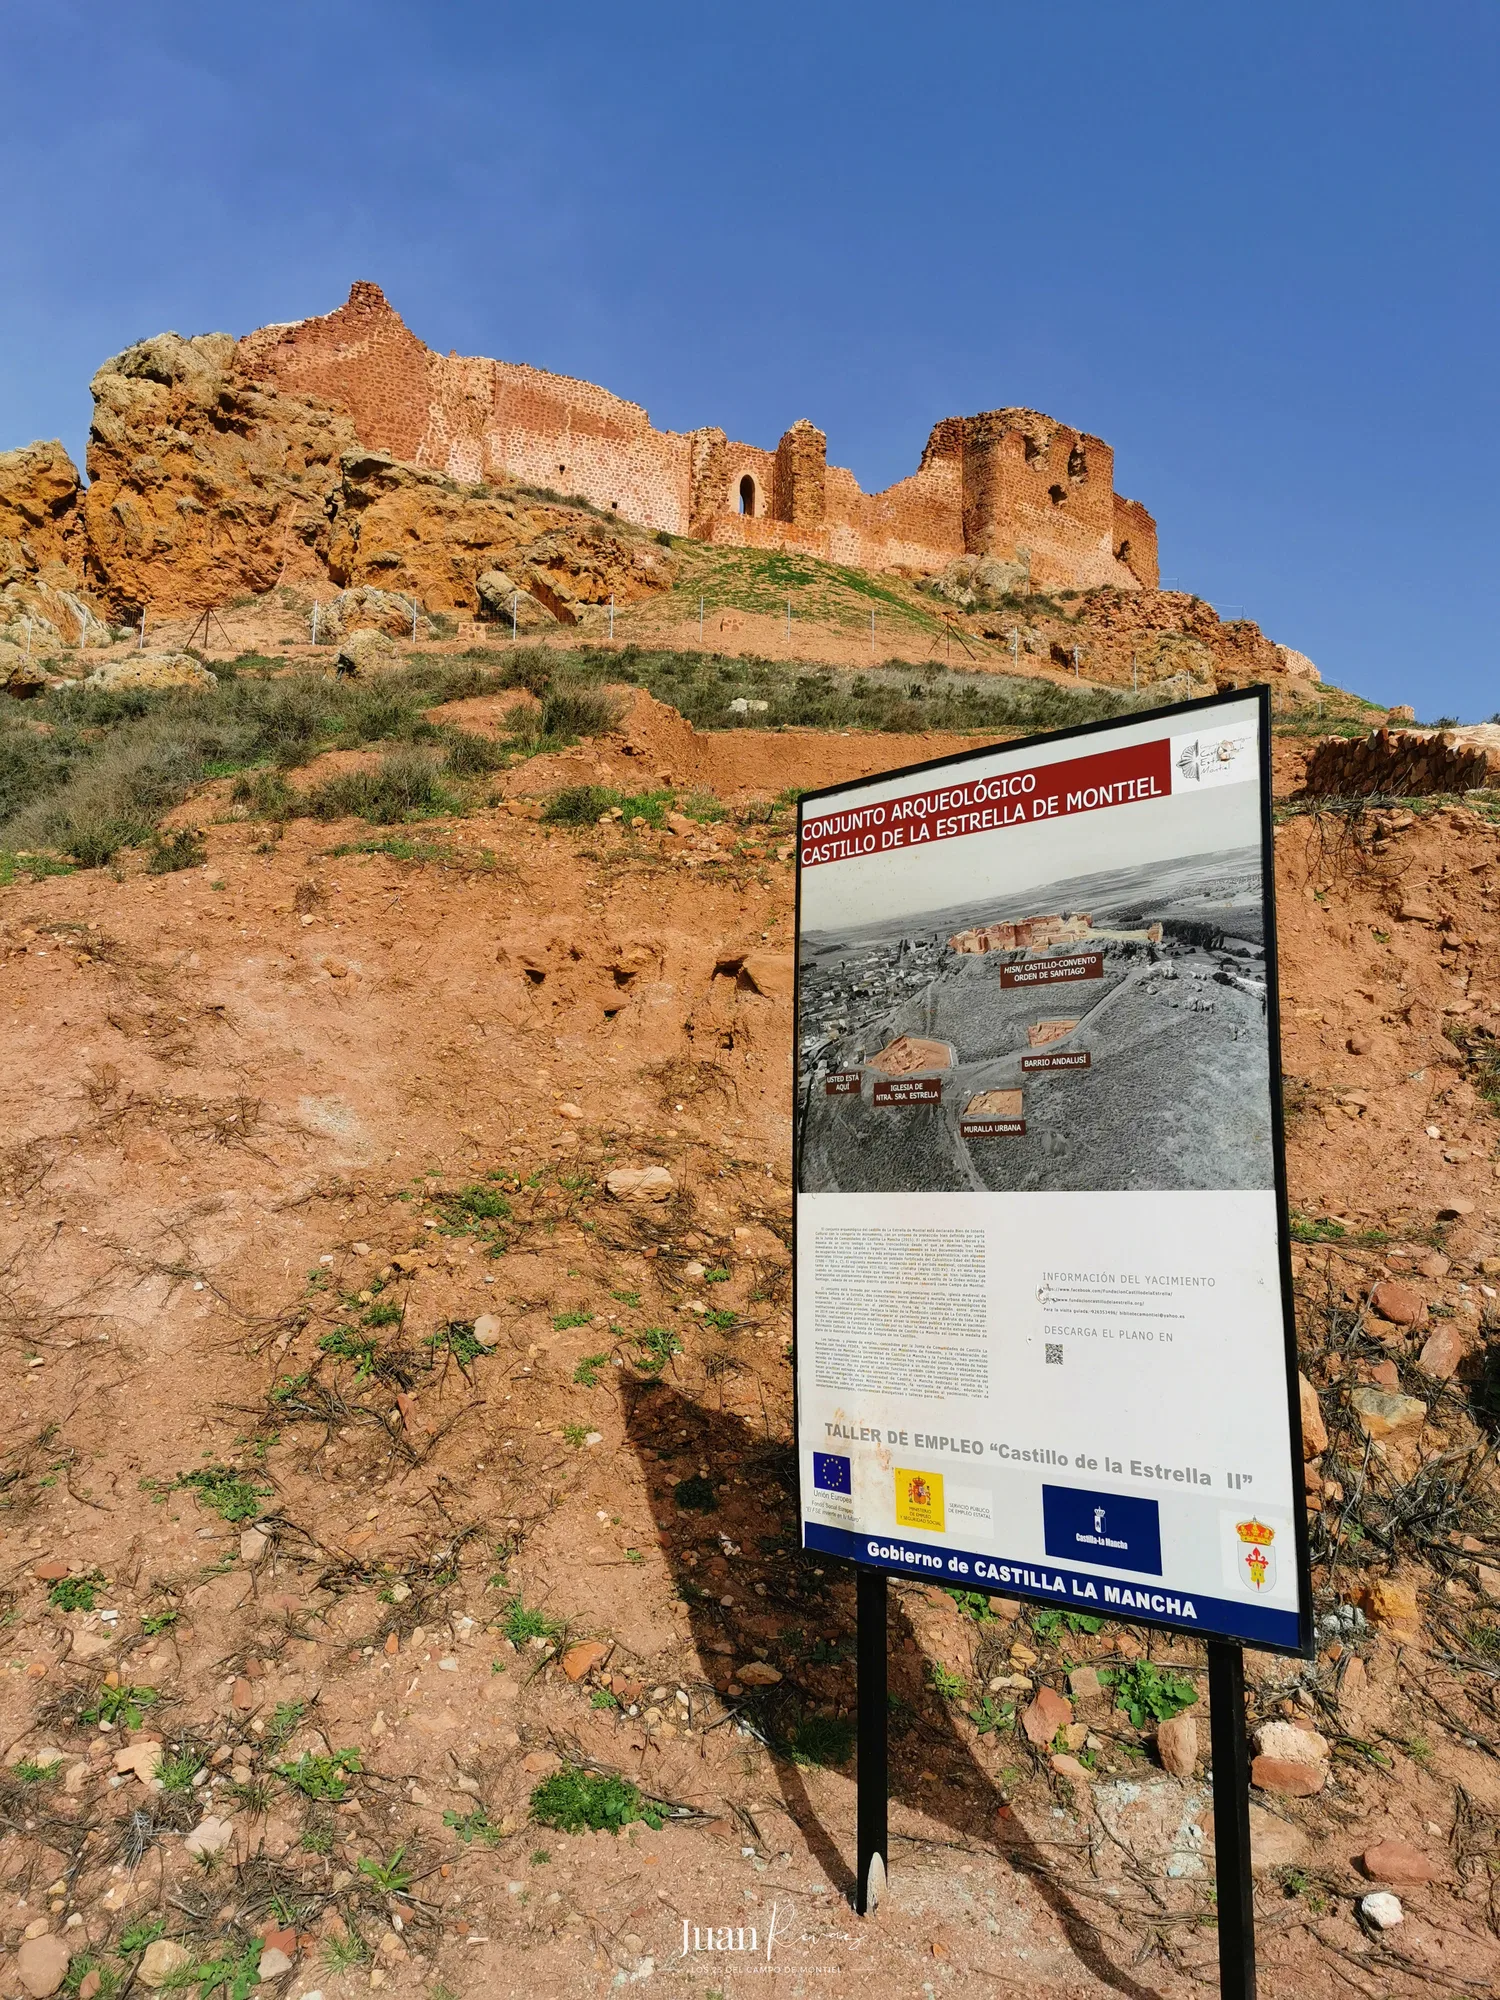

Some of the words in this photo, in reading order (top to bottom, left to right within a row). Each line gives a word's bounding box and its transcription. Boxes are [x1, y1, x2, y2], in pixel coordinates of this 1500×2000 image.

[802, 807, 885, 841] CONJUNTO
[891, 774, 1036, 820] ARQUEOLÓGICO
[802, 835, 876, 866] CASTILLO
[882, 831, 903, 849] DE
[909, 825, 930, 843] LA
[937, 805, 1026, 838] ESTRELLA
[1034, 798, 1058, 818] DE
[1066, 776, 1162, 813] MONTIEL
[1024, 956, 1096, 972] CASTILLO-CONVENTO
[1014, 972, 1038, 982] ORDEN
[1050, 967, 1086, 978] SANTIAGO
[1024, 1058, 1050, 1068] BARRIO
[1052, 1054, 1086, 1065] ANDALUSÍ
[826, 1075, 844, 1083] USTED
[836, 1082, 850, 1091] AQUÍ
[890, 1084, 913, 1092] IGLESIA
[910, 1090, 938, 1099] ESTRELLA
[964, 1125, 992, 1133] MURALLA
[994, 1124, 1021, 1132] URBANA
[1043, 1271, 1115, 1283] INFORMACIÓN
[1120, 1274, 1140, 1284] DEL
[1145, 1276, 1216, 1287] YACIMIENTO
[1044, 1326, 1098, 1337] DESCARGA
[1102, 1329, 1114, 1338] EL
[1119, 1330, 1154, 1341] PLANO
[1160, 1332, 1173, 1342] EN
[824, 1422, 882, 1444] TALLER
[887, 1430, 908, 1446] DE
[914, 1432, 984, 1456] EMPLEO
[1075, 1453, 1098, 1470] de
[1104, 1456, 1123, 1474] la
[1130, 1460, 1212, 1486] Estrella
[868, 1542, 944, 1569] Gobierno
[948, 1554, 969, 1574] de
[974, 1560, 1066, 1594] CASTILLA
[1072, 1579, 1098, 1600] LA
[1104, 1585, 1198, 1619] MANCHA
